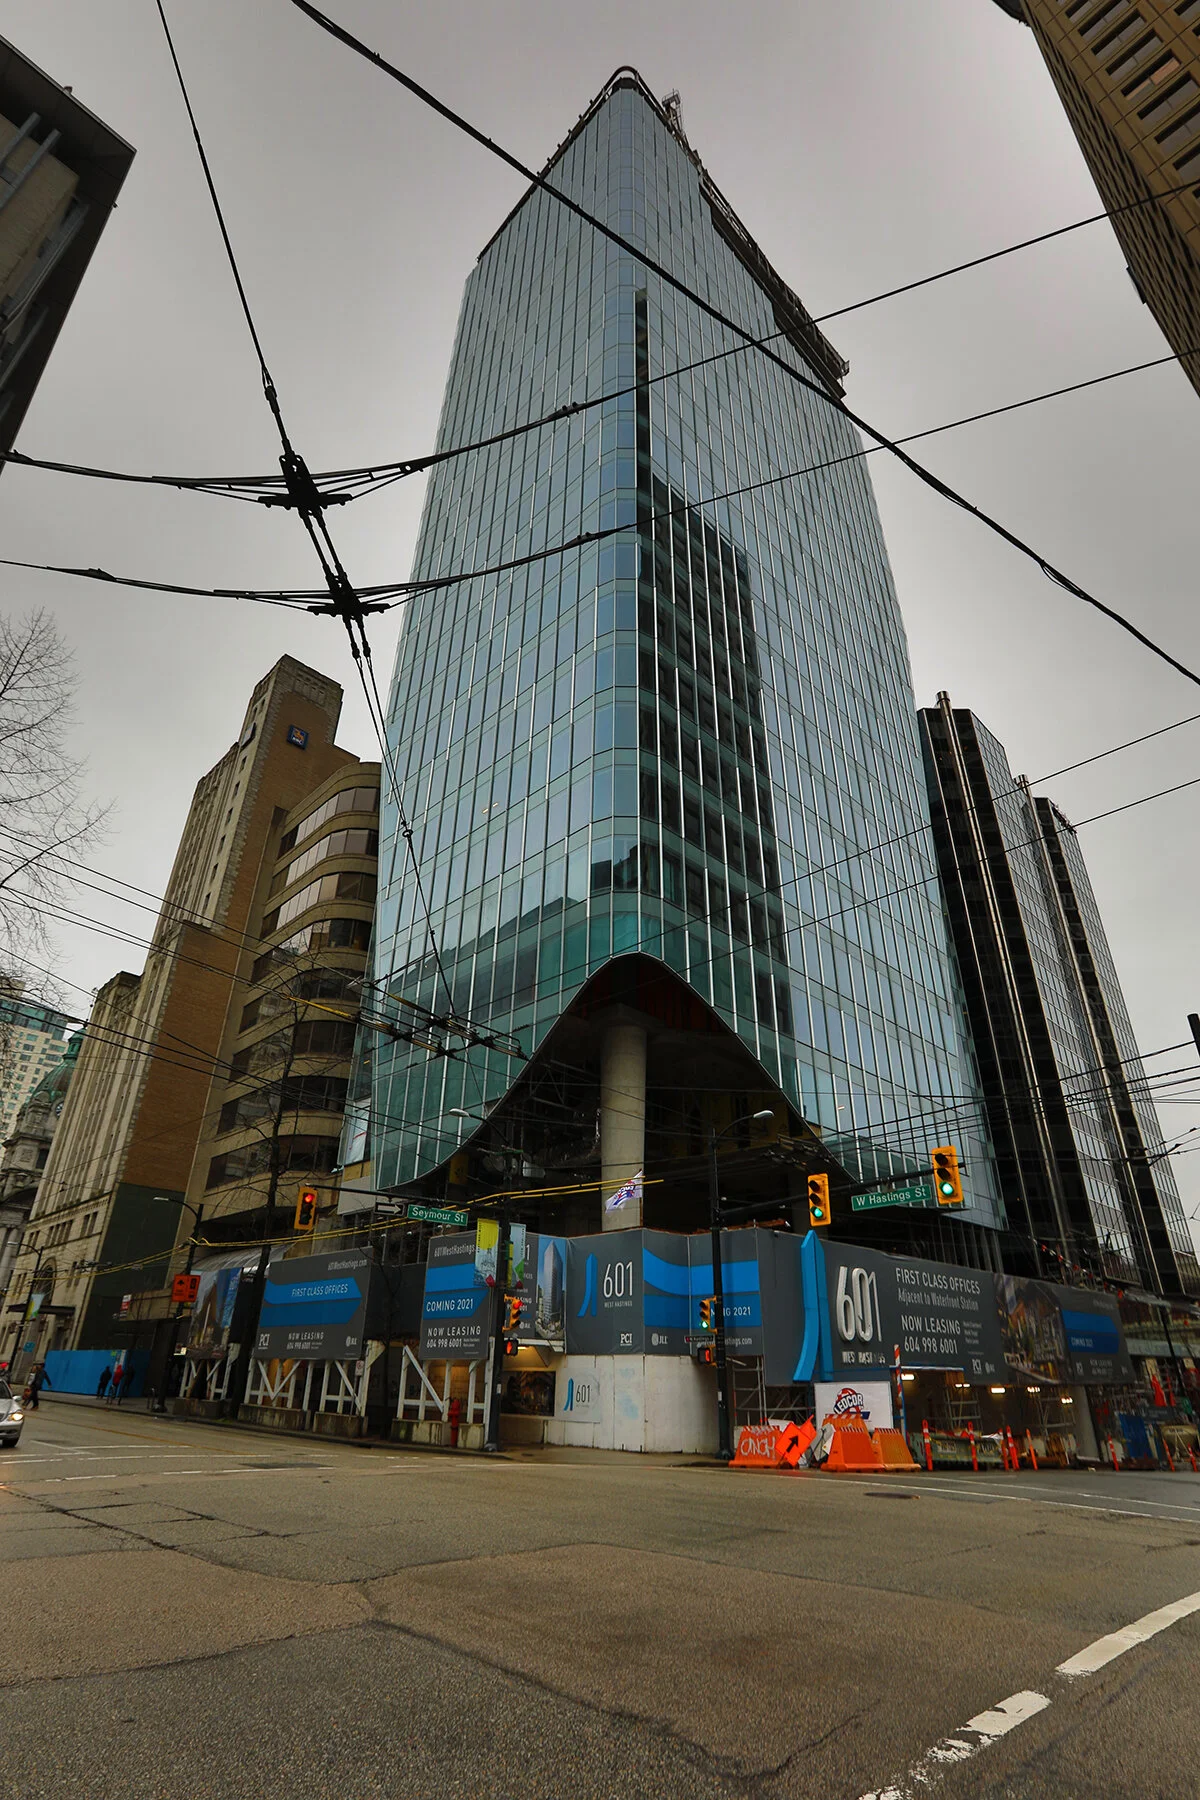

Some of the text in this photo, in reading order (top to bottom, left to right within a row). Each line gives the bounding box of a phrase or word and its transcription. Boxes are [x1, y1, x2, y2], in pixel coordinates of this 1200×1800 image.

[856, 1188, 927, 1206] W Hastings St
[412, 1207, 464, 1223] Seymour St
[603, 1261, 634, 1298] 601
[895, 1267, 981, 1295] FIRST CLASS OFFICES
[291, 1283, 348, 1297] FIRST CLASS OFFICES
[426, 1298, 473, 1312] COMING 2021
[836, 1266, 883, 1343] 601
[897, 1287, 979, 1311] Adjacent to Waterfront Station
[733, 1306, 751, 1317] 2021
[428, 1325, 481, 1337] NOW LEASING
[901, 1315, 922, 1333] NOW
[925, 1317, 961, 1335] LEASING
[259, 1333, 271, 1347] PCI
[288, 1331, 324, 1340] NOW LEASING
[426, 1339, 437, 1348] 604
[438, 1339, 448, 1348] 998
[449, 1338, 462, 1348] 6001
[620, 1333, 633, 1344] PCI
[904, 1337, 920, 1352] 604
[922, 1337, 938, 1353] 998
[939, 1338, 958, 1356] 6001
[576, 1384, 591, 1403] 601
[834, 1394, 863, 1414] LEDCOR
